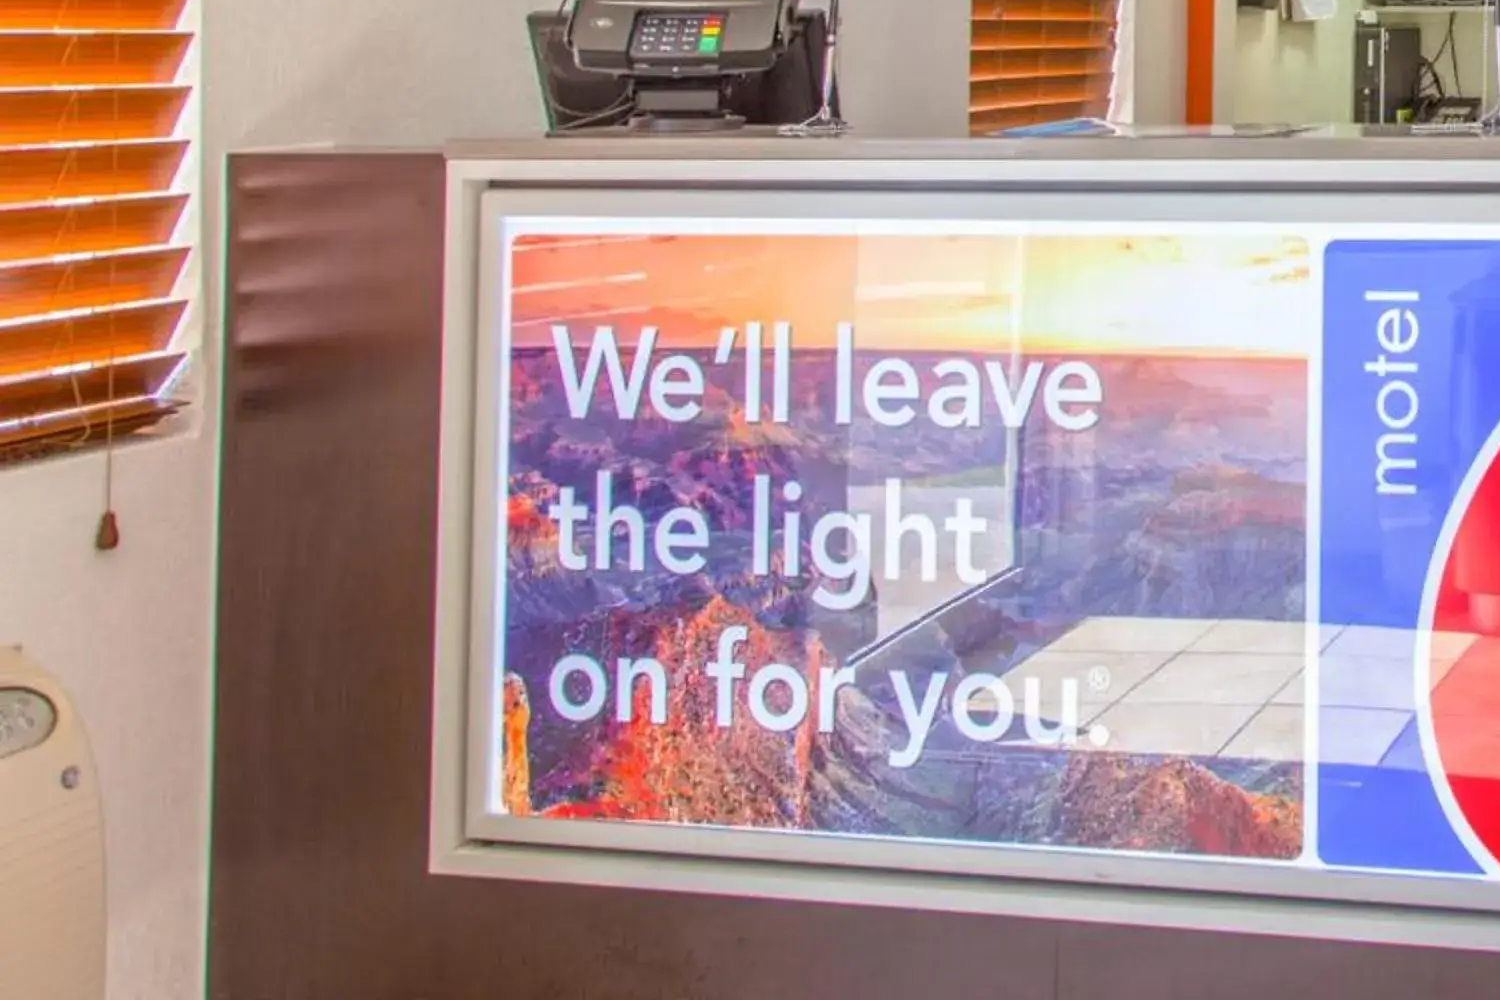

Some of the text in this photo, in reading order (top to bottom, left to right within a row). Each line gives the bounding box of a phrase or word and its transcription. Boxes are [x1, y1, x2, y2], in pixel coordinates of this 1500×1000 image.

[550, 321, 1104, 432] We'll leave
[1363, 290, 1420, 495] motel
[548, 469, 989, 611] the light
[548, 650, 668, 725] on
[706, 624, 856, 734] for
